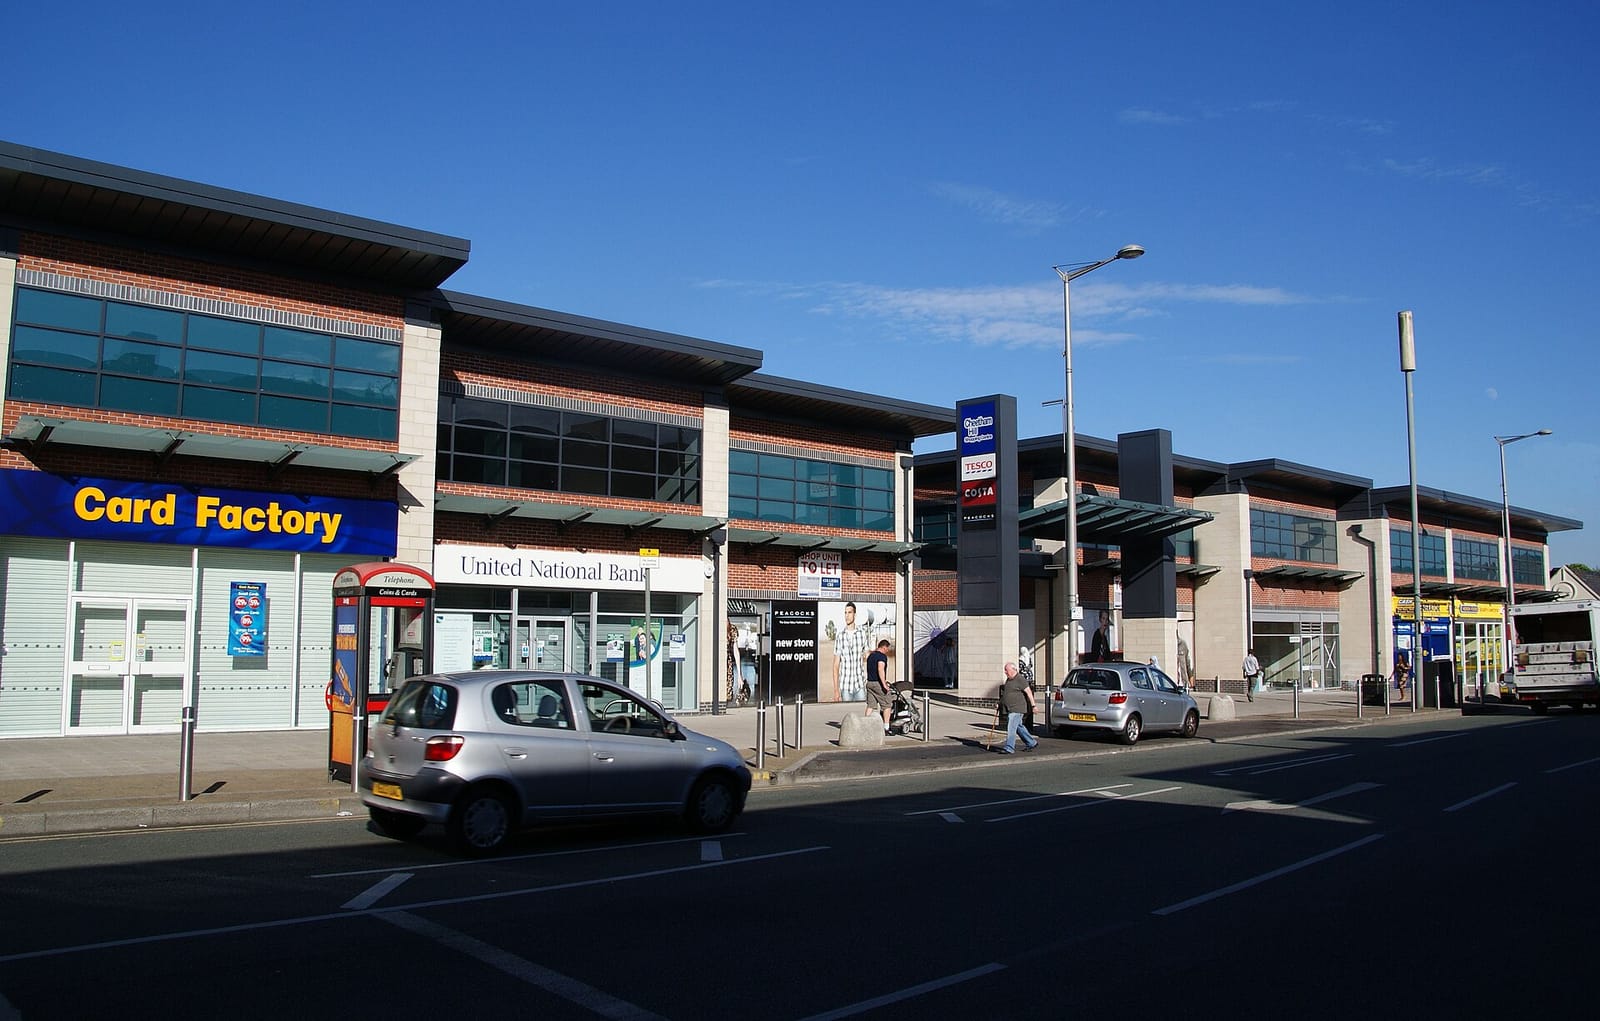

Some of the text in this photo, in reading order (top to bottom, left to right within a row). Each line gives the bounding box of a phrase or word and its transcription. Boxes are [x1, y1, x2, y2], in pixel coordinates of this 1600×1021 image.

[965, 417, 992, 428] Cheetham
[965, 460, 992, 470] TESCO
[965, 486, 994, 498] COSTA
[74, 486, 342, 544] Card Factory
[822, 553, 840, 561] UNIT
[461, 556, 646, 582] United National Bank
[801, 562, 839, 575] TO LET
[384, 576, 415, 584] Telephone
[794, 638, 814, 647] store
[794, 652, 814, 662] open
